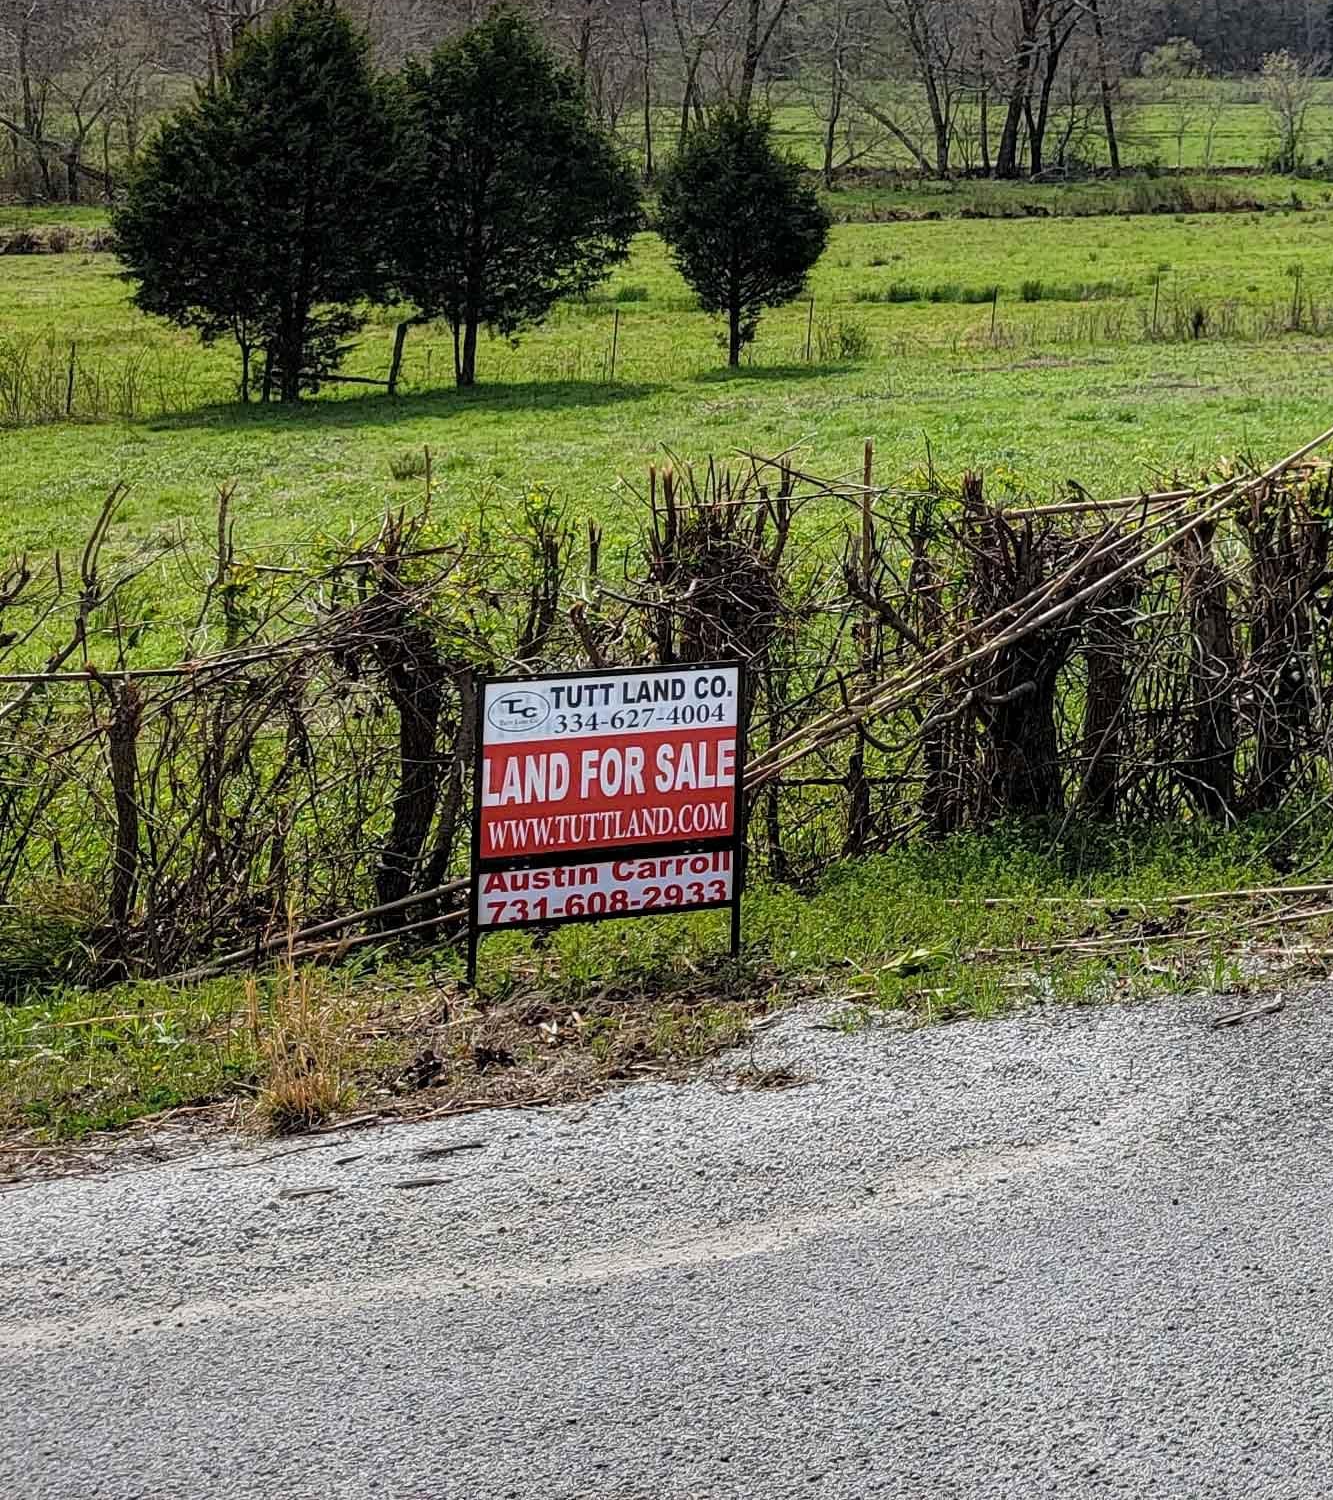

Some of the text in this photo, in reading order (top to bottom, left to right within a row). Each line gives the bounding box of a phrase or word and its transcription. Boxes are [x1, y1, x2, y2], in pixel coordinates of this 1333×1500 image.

[550, 675, 733, 709] TUTT LAND CO.
[554, 703, 725, 734] 334-627-4004
[482, 739, 736, 808] LAND FOR SALE
[488, 802, 728, 850] WWW.TUTTLAND.COM
[483, 851, 730, 894] Austin Carroll
[486, 879, 727, 925] 731-608-2933
